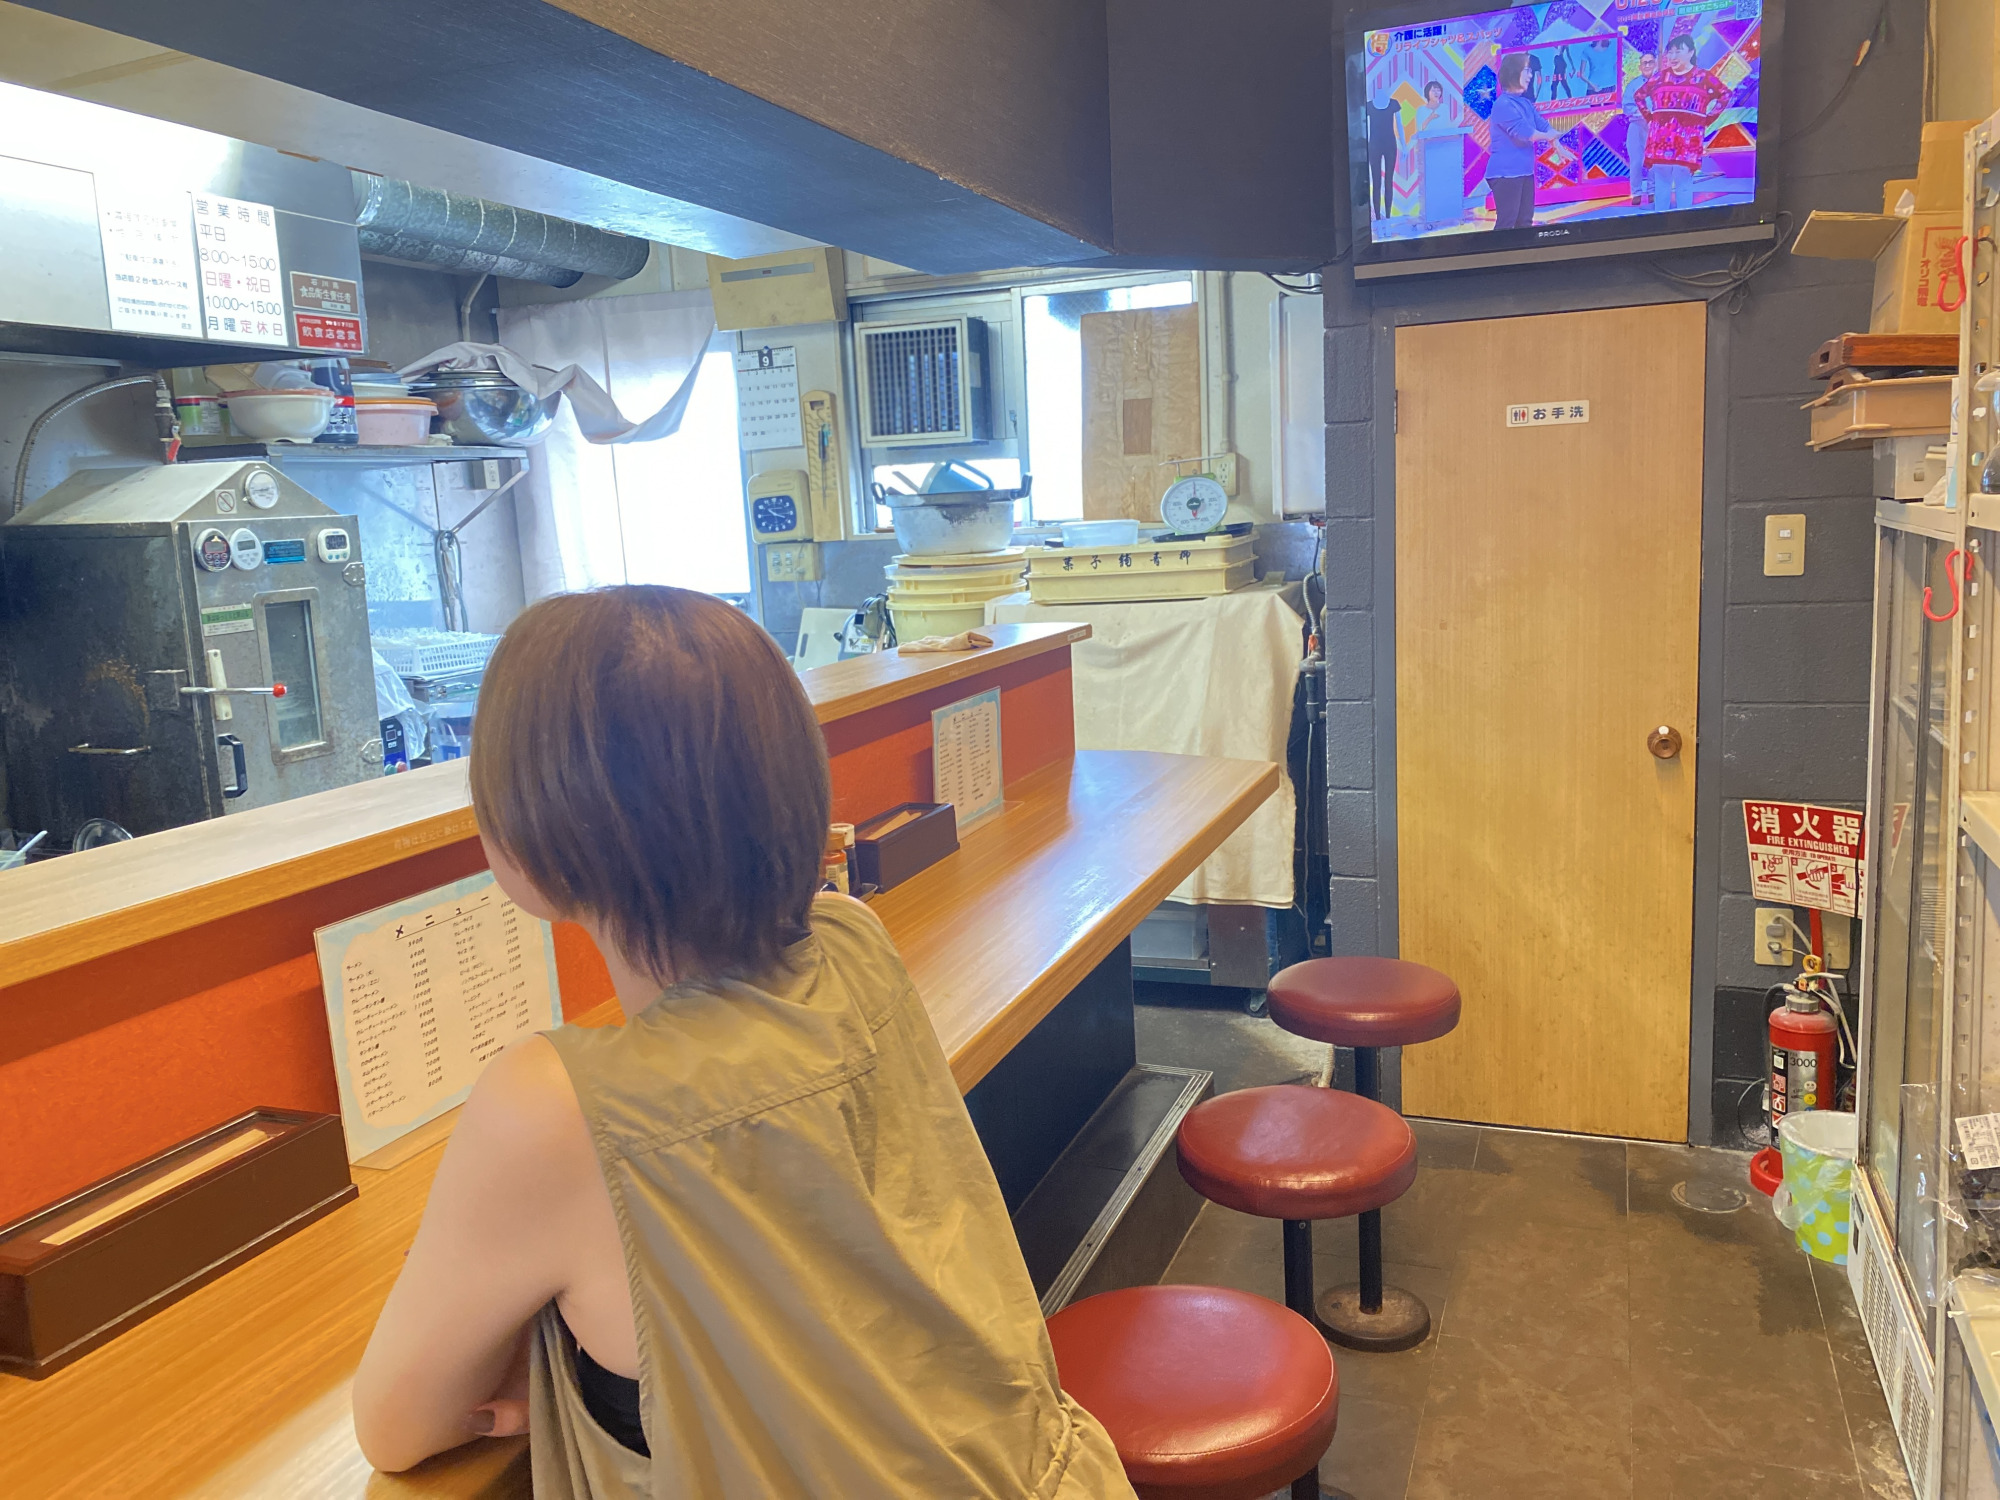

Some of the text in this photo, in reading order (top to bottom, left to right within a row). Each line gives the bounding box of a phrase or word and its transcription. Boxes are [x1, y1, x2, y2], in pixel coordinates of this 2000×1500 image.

[196, 199, 270, 226] 営業時間
[200, 224, 226, 242] 平日
[1538, 229, 1570, 238] PRODIA
[205, 271, 271, 293] 日曜・祝日
[299, 285, 351, 303] 食品衛生責任者
[208, 316, 283, 336] 月曜定休日
[302, 326, 357, 341] 飲食店営業
[762, 356, 770, 367] 9
[1533, 406, 1584, 420] お手洗
[1751, 805, 1860, 846] 消火器
[1766, 835, 1850, 856] FIRE EXTINGUISHER
[395, 896, 489, 939] メニュー
[1789, 1057, 1818, 1068] 3000
